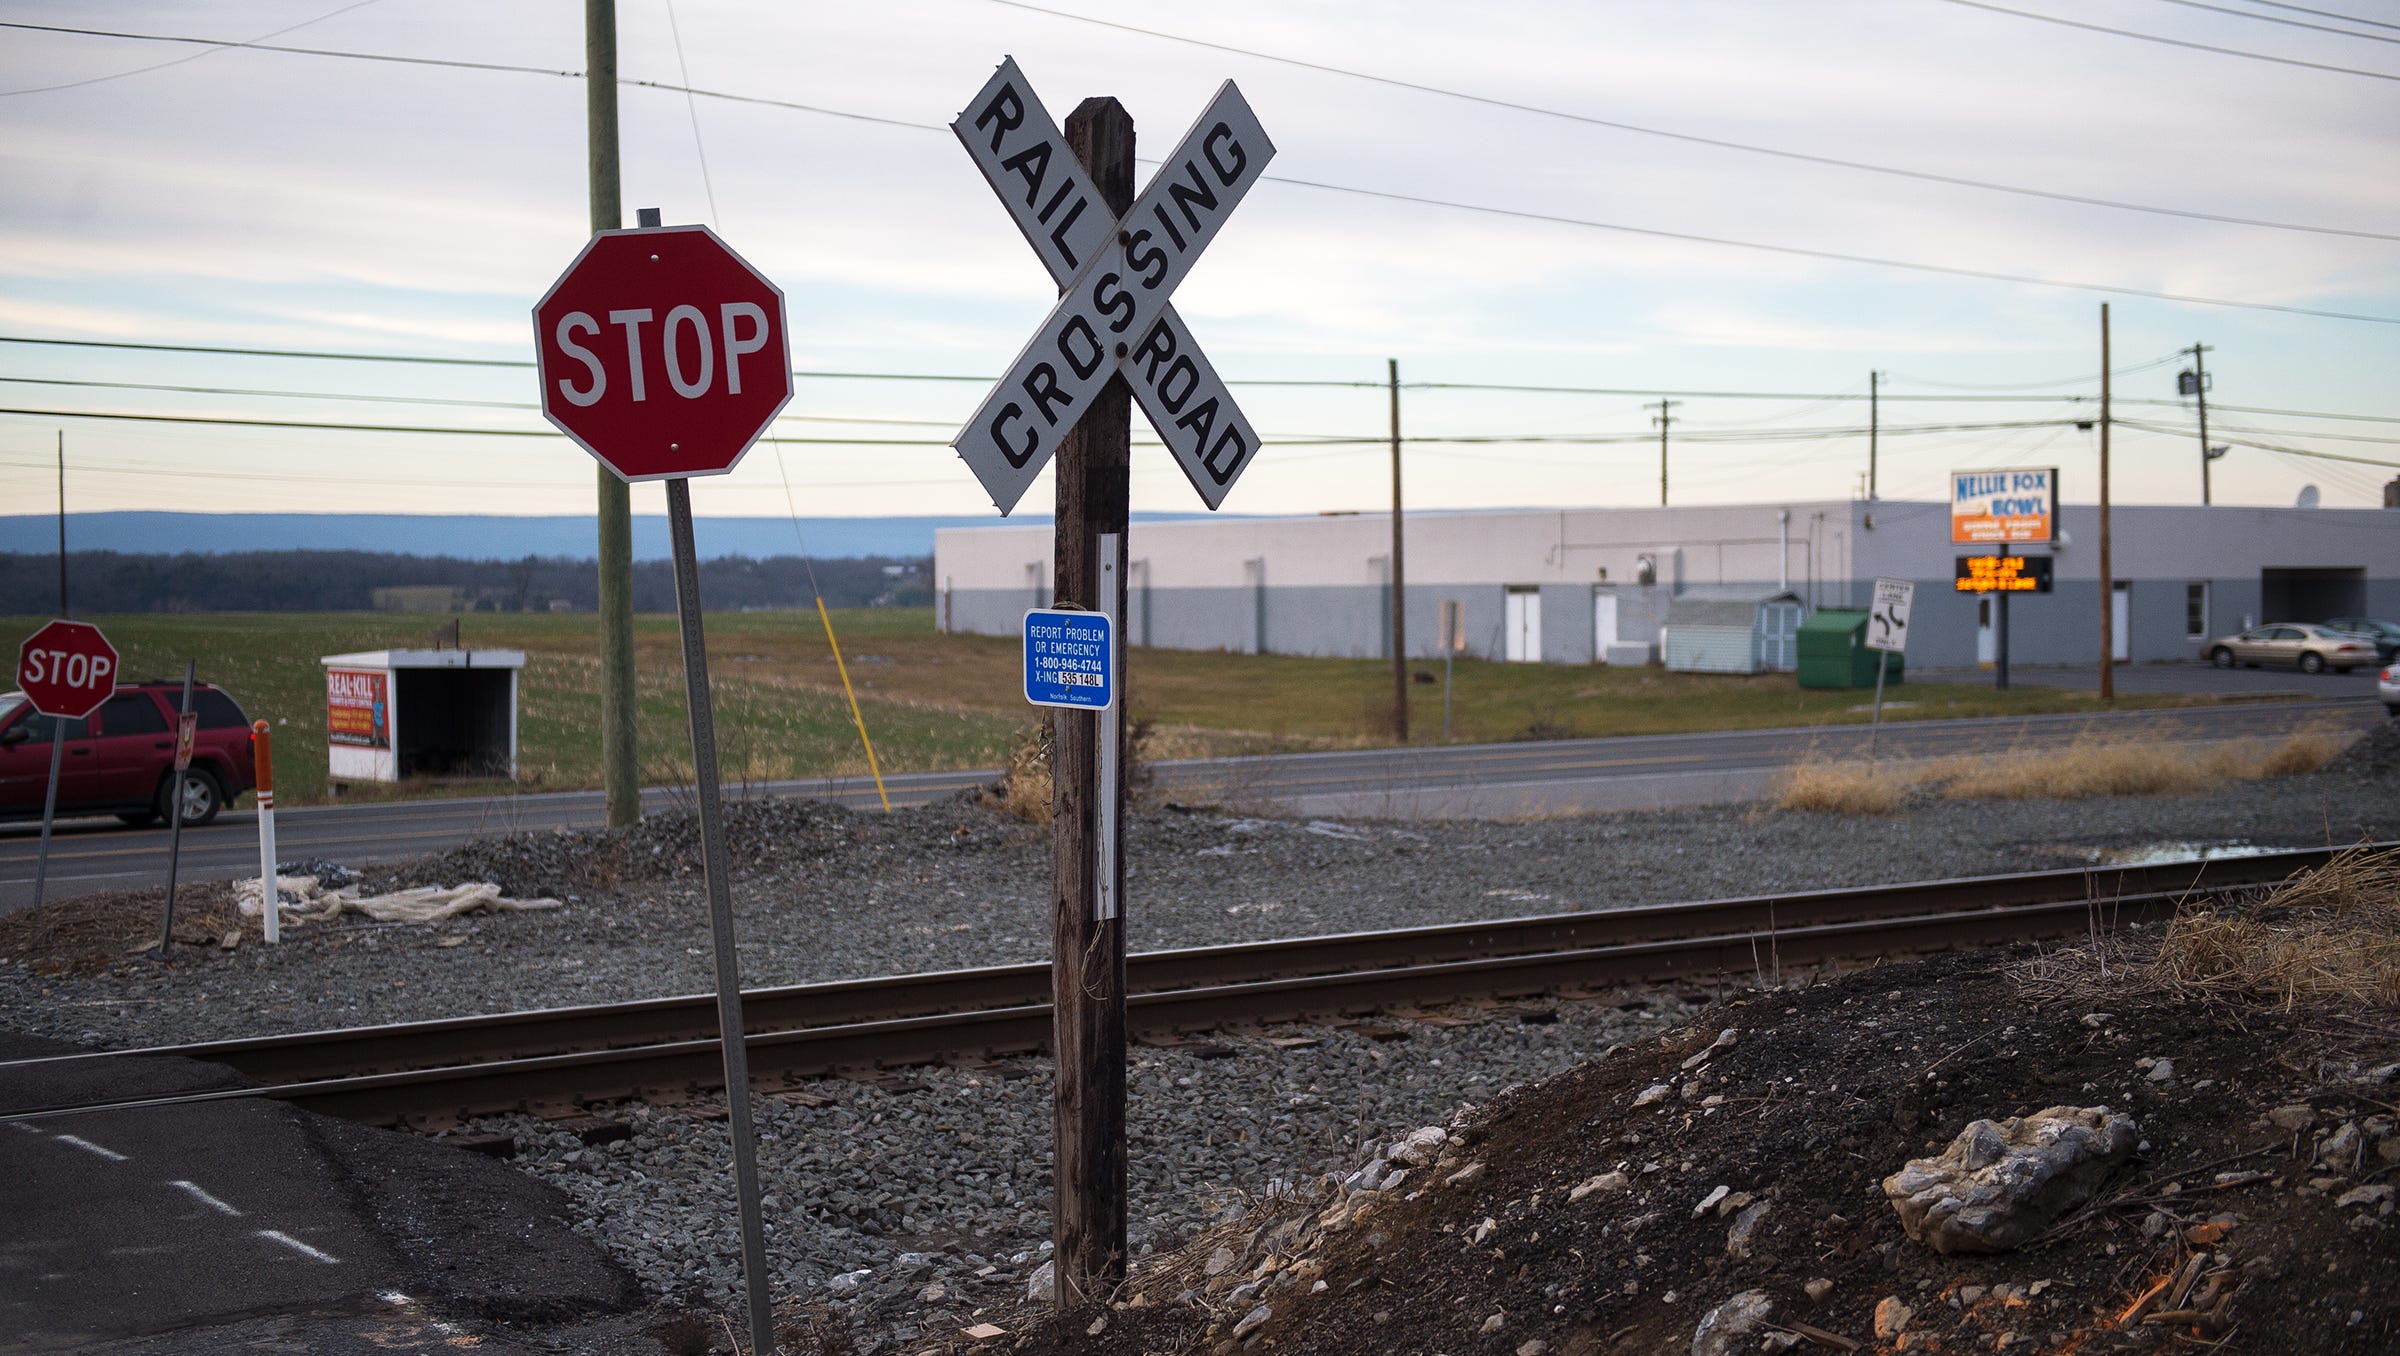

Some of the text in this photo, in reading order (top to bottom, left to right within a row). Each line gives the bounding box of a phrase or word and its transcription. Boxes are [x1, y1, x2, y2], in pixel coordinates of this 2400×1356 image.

[975, 81, 1088, 271] RAIL
[990, 121, 1247, 469] CROSSING
[556, 301, 769, 407] STOP
[1132, 317, 1247, 486] ROAD
[1957, 474, 2046, 501] NELLIE FOX
[1992, 498, 2046, 517] BOWL
[1030, 626, 1105, 642] REPORT PROBLEM
[1035, 641, 1100, 656] OR EMERGENCY
[25, 648, 110, 689] STOP
[1035, 656, 1102, 672] 1-800-946-4744
[1035, 670, 1099, 686] X-ING 535 148L
[1070, 694, 1092, 702] Southern
